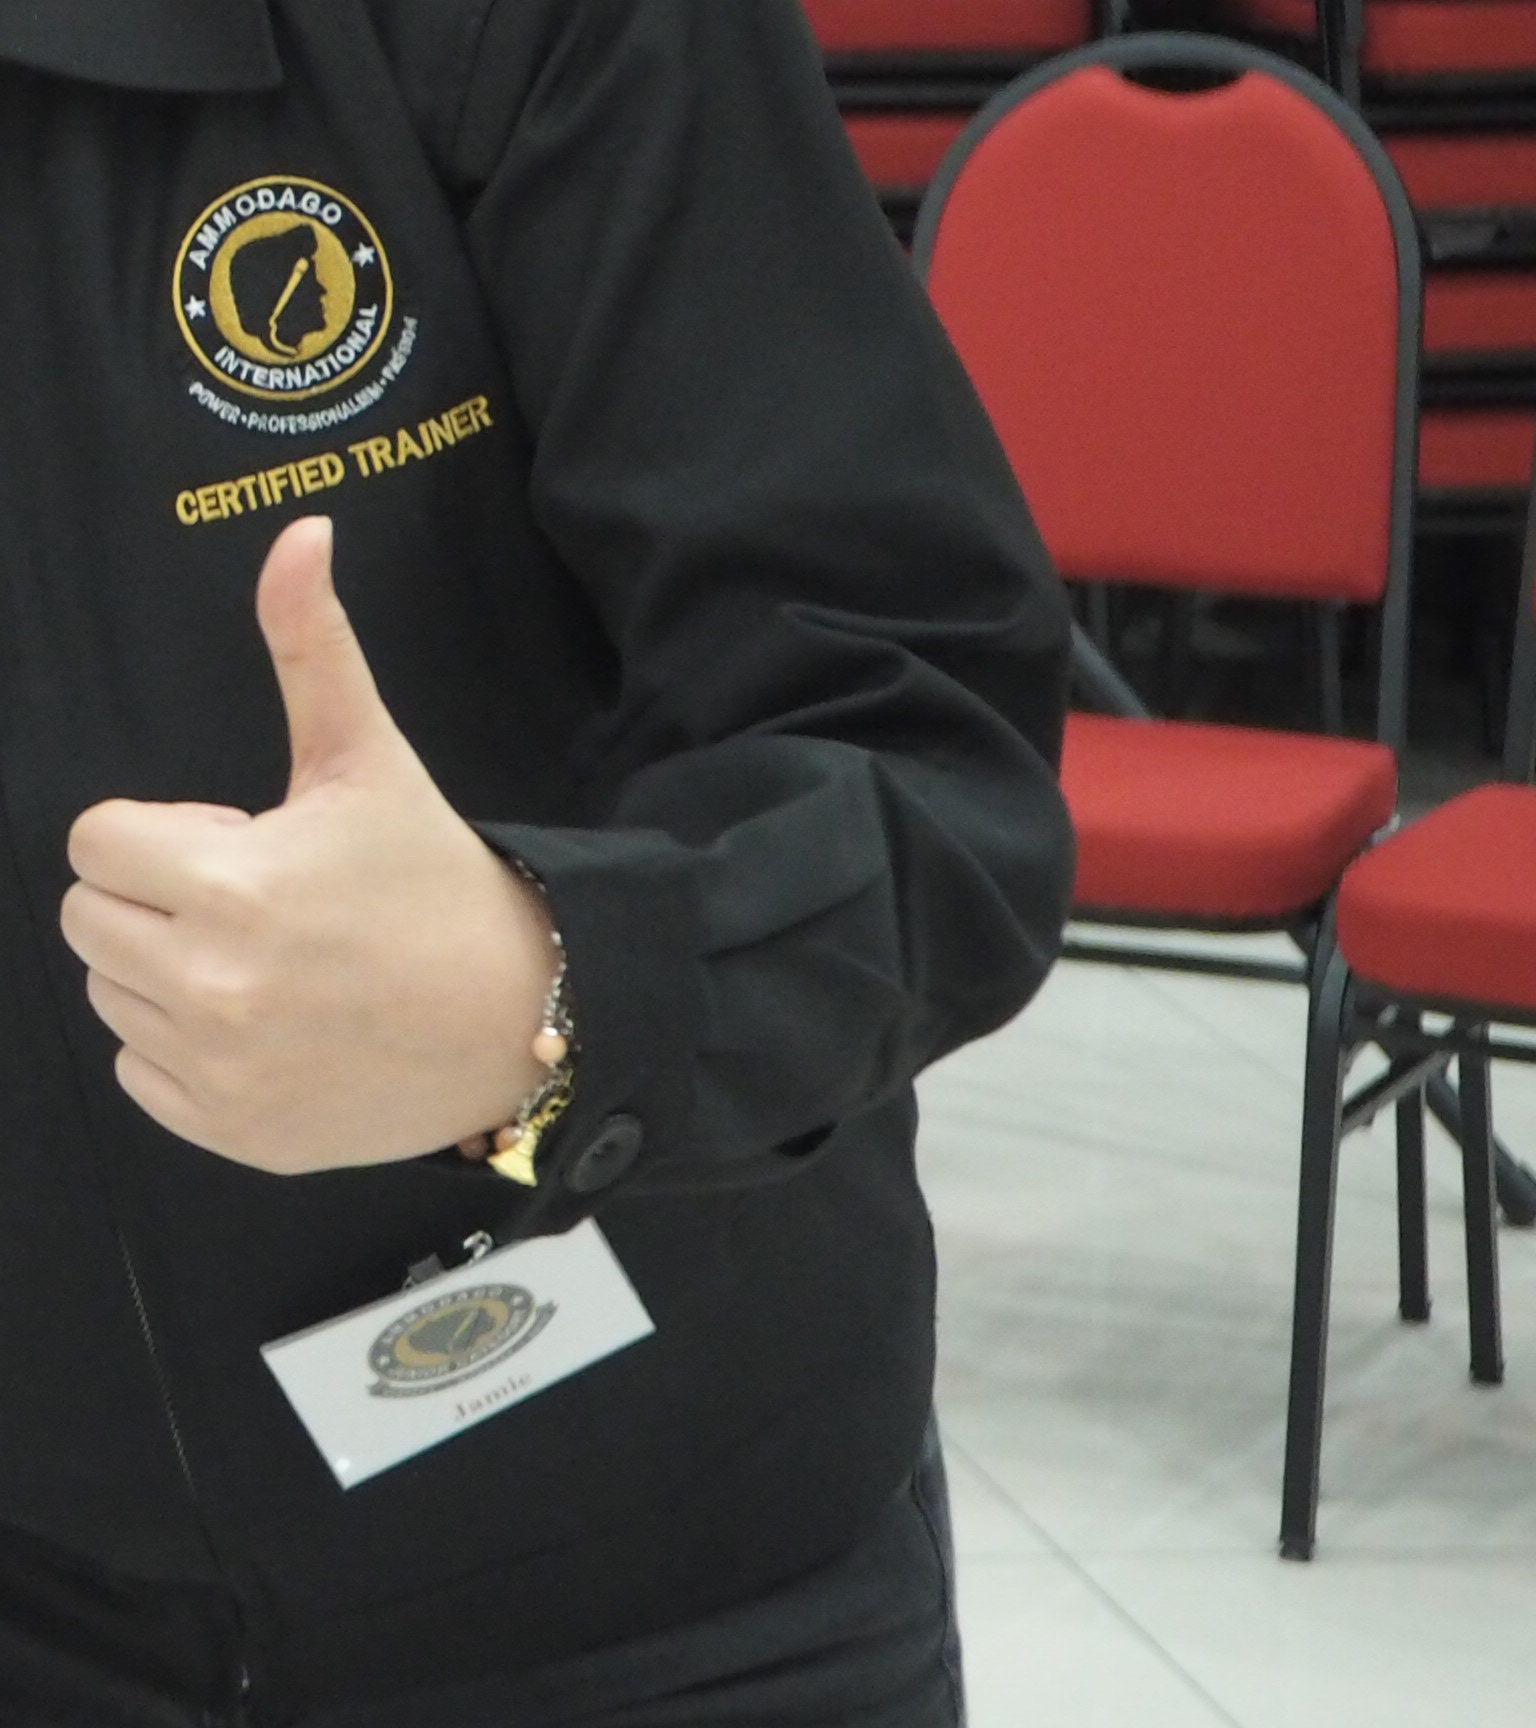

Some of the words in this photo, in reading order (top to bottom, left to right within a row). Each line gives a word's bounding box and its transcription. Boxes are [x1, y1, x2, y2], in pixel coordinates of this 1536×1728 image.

[189, 187, 343, 270] AMMODAGO
[214, 301, 378, 391] INTERNATIONAL
[175, 452, 346, 526] CERTIFIED
[348, 394, 494, 478] TRAINER
